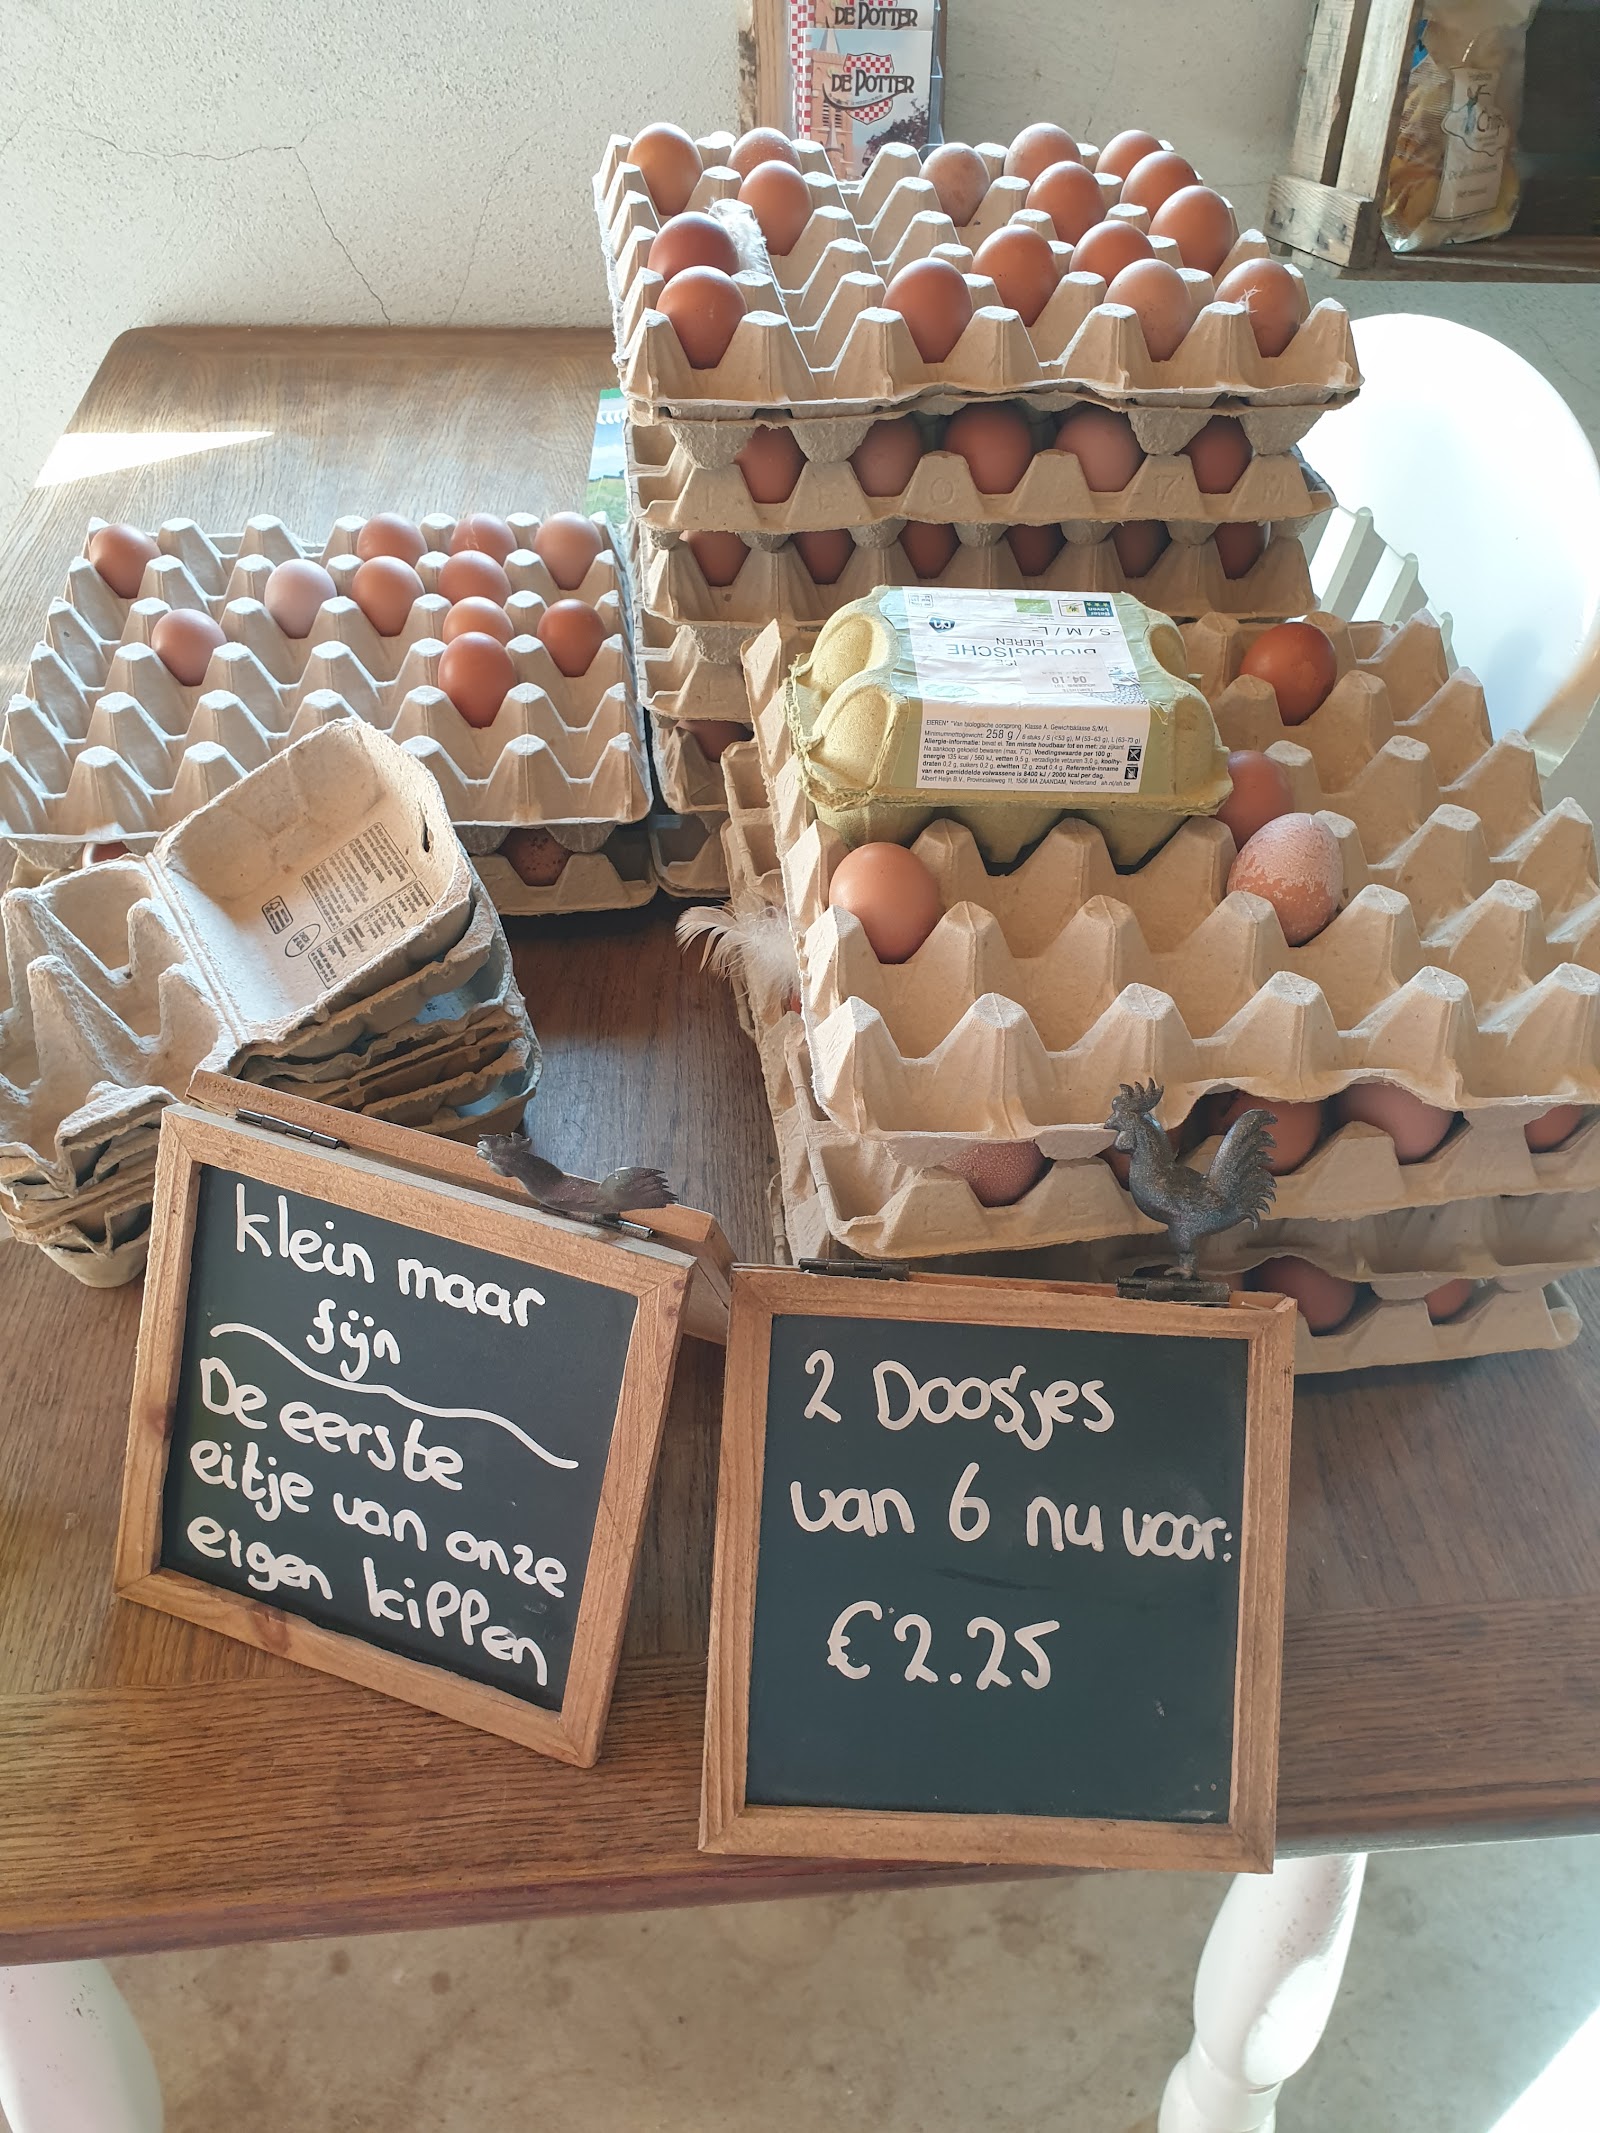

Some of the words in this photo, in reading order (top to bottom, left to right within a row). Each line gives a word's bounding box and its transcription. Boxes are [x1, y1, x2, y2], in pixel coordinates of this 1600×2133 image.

[835, 6, 856, 26] DE
[858, 2, 918, 28] POTTER
[832, 74, 852, 92] DE
[855, 69, 915, 96] POTTER
[995, 637, 1044, 648] EIEREN
[1066, 627, 1082, 636] M
[1051, 675, 1087, 684] 04.10
[986, 729, 1004, 738] 258
[1008, 731, 1013, 740] g
[237, 1184, 374, 1283] klein
[399, 1257, 545, 1327] maar
[200, 1358, 268, 1430] De
[279, 1401, 464, 1491] eerste
[804, 1350, 842, 1422] 2
[872, 1360, 1115, 1451] Doosjes
[191, 1440, 314, 1521] eitje
[333, 1492, 427, 1551] van
[445, 1530, 568, 1598] onze
[790, 1481, 915, 1537] van
[948, 1462, 991, 1542] 6
[1026, 1496, 1105, 1552] nu
[1122, 1508, 1233, 1564] voor:
[187, 1516, 332, 1600] eigen
[364, 1557, 548, 1686] kippen
